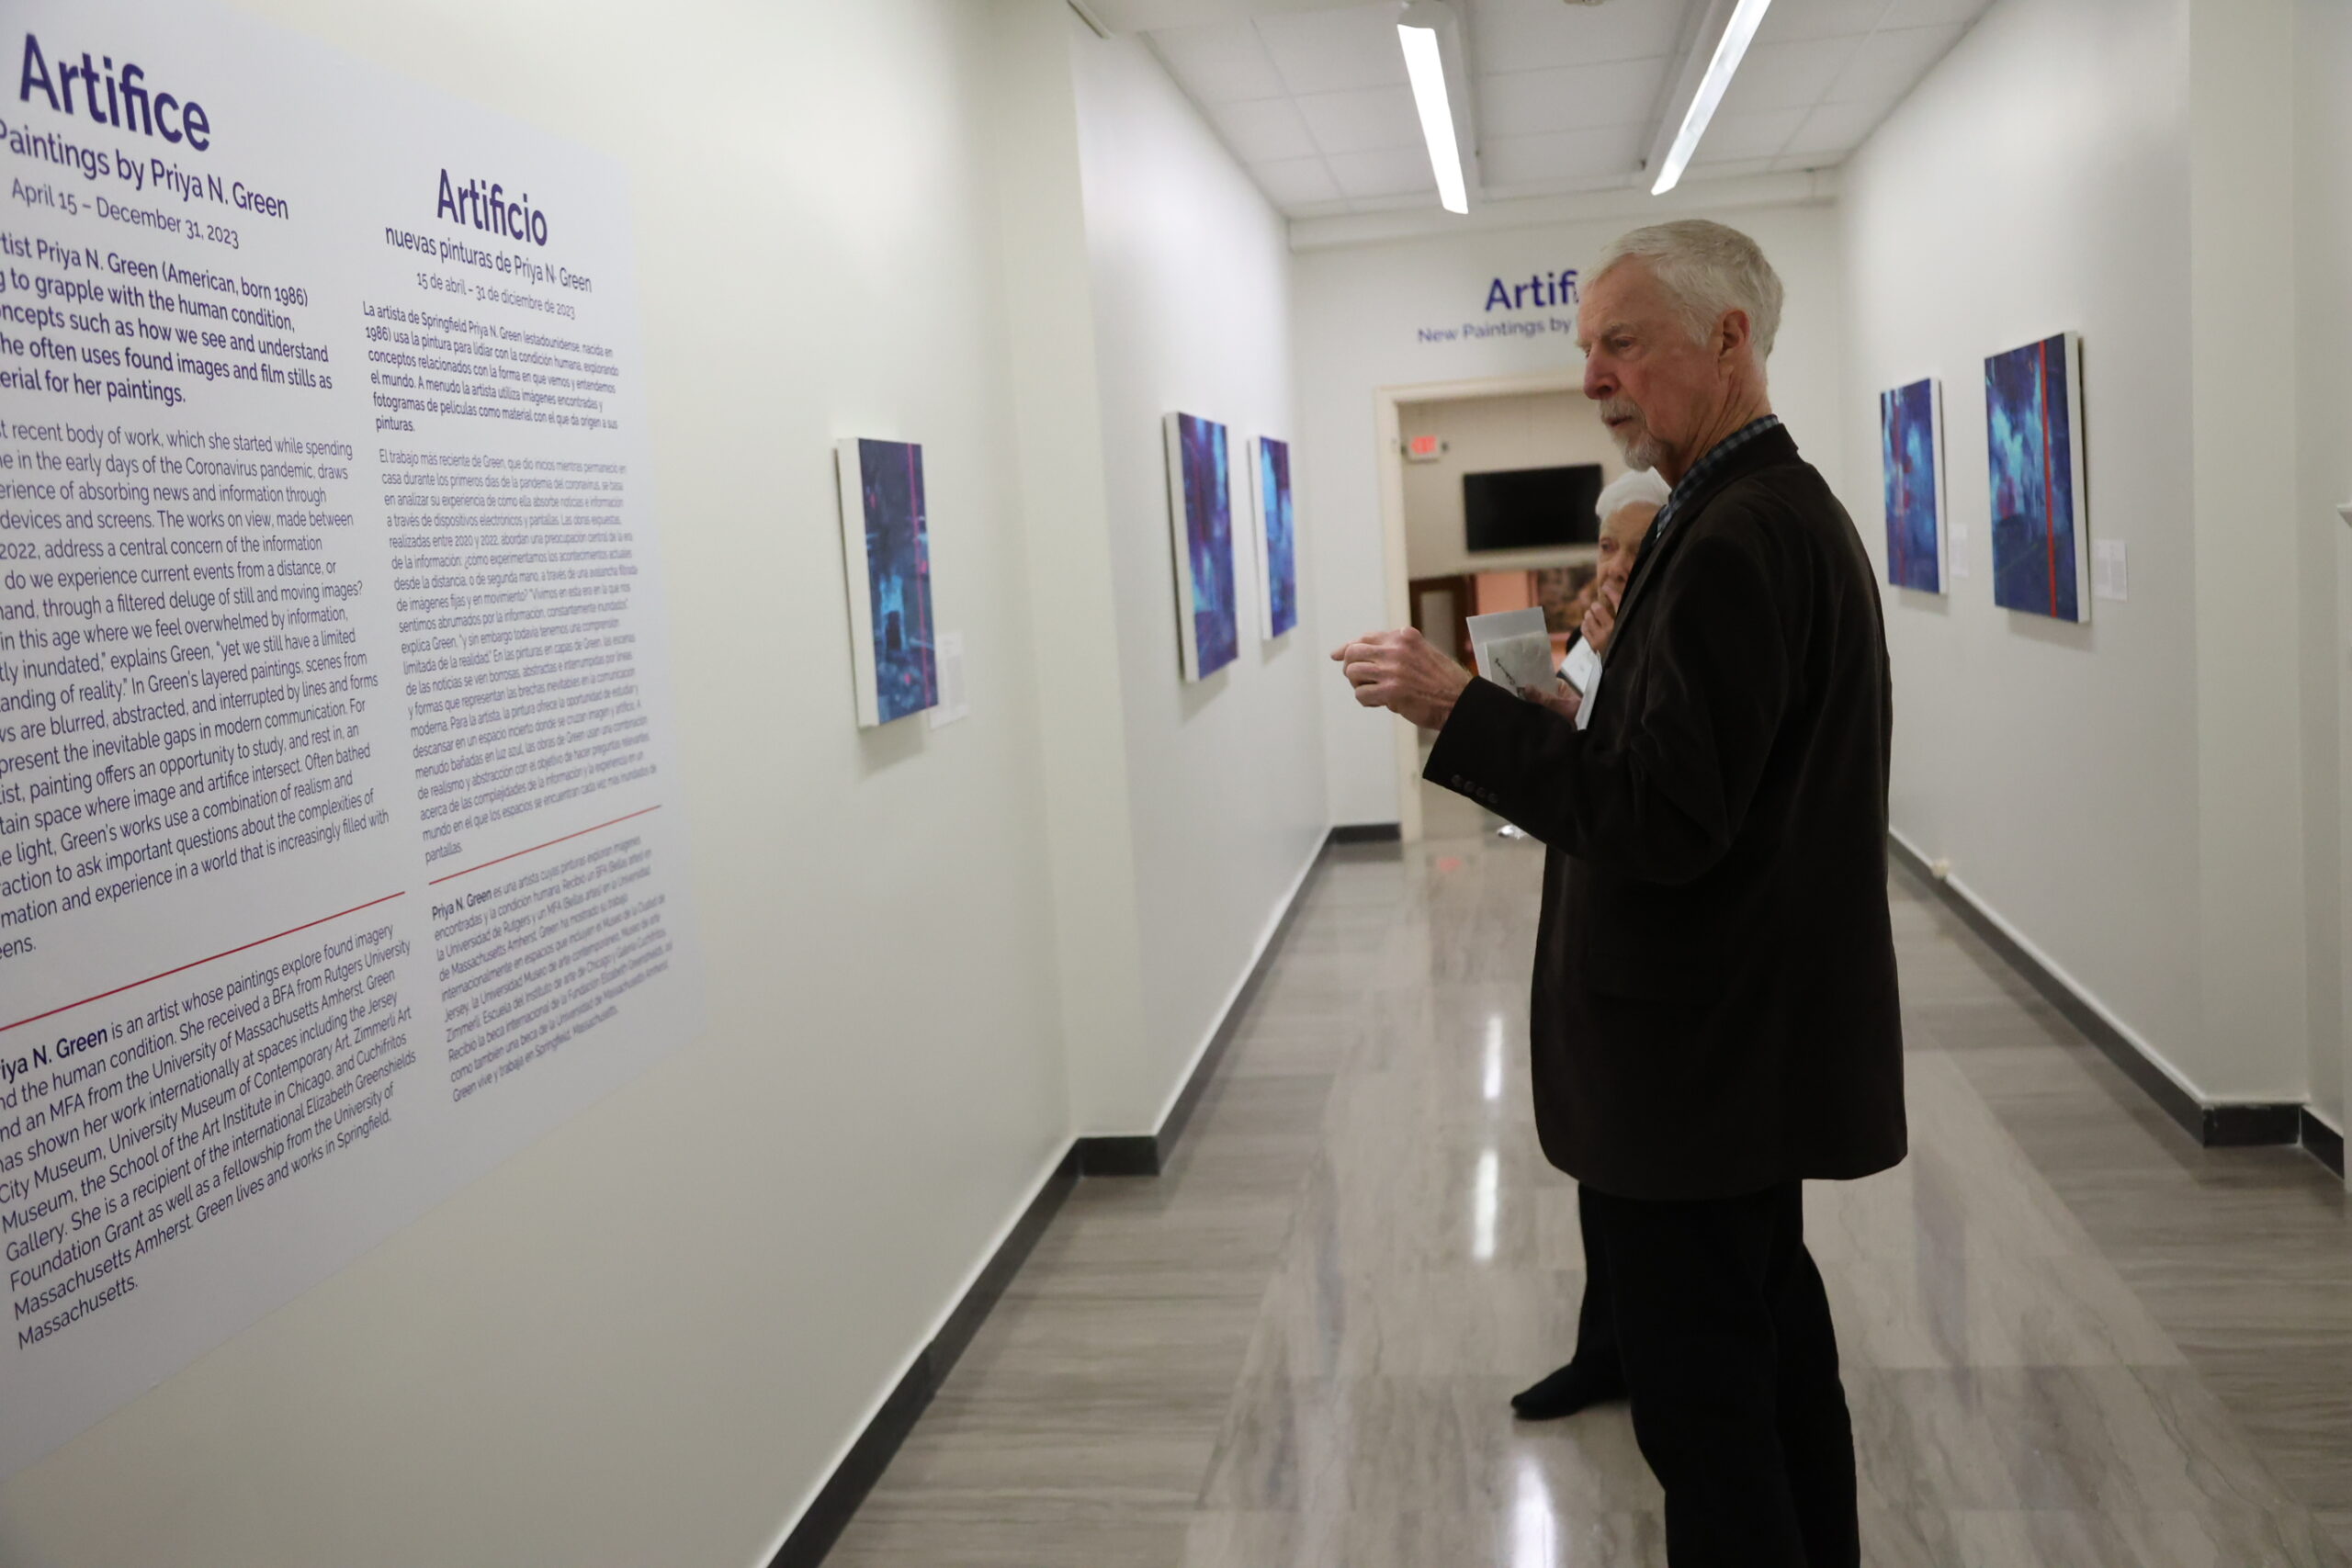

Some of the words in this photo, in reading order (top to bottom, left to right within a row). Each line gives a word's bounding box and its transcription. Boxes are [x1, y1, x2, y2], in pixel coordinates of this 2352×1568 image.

[19, 33, 210, 152] Artifice
[115, 148, 145, 192] by
[150, 158, 204, 203] Priya
[207, 174, 229, 206] N.
[232, 181, 289, 220] Green
[436, 168, 548, 247] Artificio
[12, 177, 56, 209] April
[58, 191, 78, 216] 15
[96, 196, 182, 233] December
[185, 219, 204, 241] 31,
[207, 224, 240, 250] 2023
[0, 232, 33, 259] tist
[36, 238, 82, 271] Priya
[85, 247, 104, 271] N.
[107, 252, 159, 280] Green
[162, 261, 239, 297] (American,
[241, 276, 272, 300] born
[274, 286, 309, 308] 1986)
[385, 227, 437, 256] nuevas
[439, 237, 493, 270] pinturas
[495, 251, 513, 275] de
[514, 254, 544, 286] Priya
[560, 266, 593, 293] Green
[10, 267, 30, 291] to
[35, 276, 105, 305] grapple
[107, 285, 145, 309] with
[148, 289, 175, 313] the
[177, 293, 229, 321] human
[231, 308, 295, 333] condition,
[416, 272, 429, 290] 15
[429, 273, 444, 291] de
[445, 276, 468, 296] abril
[475, 285, 487, 302] 31
[487, 286, 500, 302] de
[544, 299, 556, 314] de
[69, 312, 111, 334] such
[115, 320, 135, 338] as
[138, 317, 173, 342] how
[175, 328, 198, 345] we
[201, 332, 227, 349] see
[230, 333, 255, 354] and
[257, 338, 330, 363] understand
[362, 300, 376, 318] La
[377, 305, 407, 322] artista
[407, 309, 421, 325] de
[421, 311, 468, 334] Springfield
[468, 320, 490, 341] Priya
[499, 326, 523, 343] Green
[365, 325, 392, 343] 1986)
[393, 332, 411, 345] usa
[410, 331, 421, 346] la
[421, 333, 453, 352] pintura
[453, 341, 473, 356] para
[1418, 327, 1458, 344] New
[1463, 320, 1545, 337] Paintings
[1550, 317, 1573, 333] by
[0, 367, 42, 391] erial
[44, 369, 70, 393] for
[73, 372, 102, 397] her
[106, 378, 187, 408] paintings.
[29, 336, 77, 362] often
[81, 346, 121, 367] uses
[124, 346, 175, 372] found
[176, 352, 231, 382] images
[232, 362, 259, 381] and
[260, 363, 286, 385] film
[288, 367, 317, 389] stills
[319, 375, 333, 389] as
[368, 349, 417, 369] conceptos
[417, 355, 473, 376] relacionados
[472, 365, 489, 377] con
[489, 364, 498, 378] la
[370, 369, 381, 386] el
[417, 375, 425, 390] A
[425, 379, 462, 395] menudo
[461, 380, 471, 396] la
[471, 383, 497, 399] artista
[0, 509, 62, 530] devices
[65, 509, 94, 529] and
[96, 513, 155, 529] screens.
[156, 510, 185, 529] The
[187, 510, 226, 528] works
[227, 513, 243, 528] on
[244, 510, 275, 528] view,
[276, 510, 307, 527] made
[308, 510, 354, 527] between
[0, 542, 41, 560] 2022,
[44, 538, 105, 559] address
[107, 542, 117, 558] a
[119, 536, 169, 558] central
[170, 540, 224, 556] concern
[226, 535, 239, 554] of
[240, 536, 261, 553] the
[262, 534, 323, 552] information
[18, 628, 49, 650] this
[52, 630, 81, 651] age
[83, 624, 130, 644] where
[130, 624, 153, 639] we
[155, 617, 184, 638] feel
[185, 610, 269, 635] overwhelmed
[270, 610, 286, 631] by
[287, 605, 348, 626] information,
[431, 903, 456, 921] Priya
[466, 889, 492, 908] Green
[32, 1044, 52, 1069] N.
[56, 1028, 108, 1059] Green
[110, 1021, 123, 1041] is
[126, 1016, 144, 1035] an
[146, 999, 181, 1028] artist
[181, 987, 224, 1013] whose
[226, 966, 280, 1002] paintings
[281, 951, 322, 976] explore
[323, 935, 354, 961] found
[355, 925, 393, 949] imagery
[2, 1190, 78, 1235] Museum,
[80, 1174, 107, 1198] the
[108, 1145, 160, 1184] School
[161, 1136, 175, 1159] of
[176, 1131, 199, 1152] the
[202, 1117, 221, 1141] Art
[222, 1097, 273, 1131] Institute
[274, 1089, 286, 1107] in
[287, 1069, 334, 1100] Chicago,
[335, 1054, 356, 1077] and
[356, 1033, 407, 1066] Cuchifritos
[14, 1248, 132, 1322] Massachusetts
[135, 1213, 194, 1259] Amherst.
[196, 1193, 234, 1224] Green
[235, 1178, 266, 1203] lives
[266, 1160, 289, 1187] and
[290, 1146, 324, 1174] works
[324, 1139, 335, 1156] in
[336, 1108, 391, 1149] Springfield,
[18, 1276, 139, 1350] Massachusetts.
